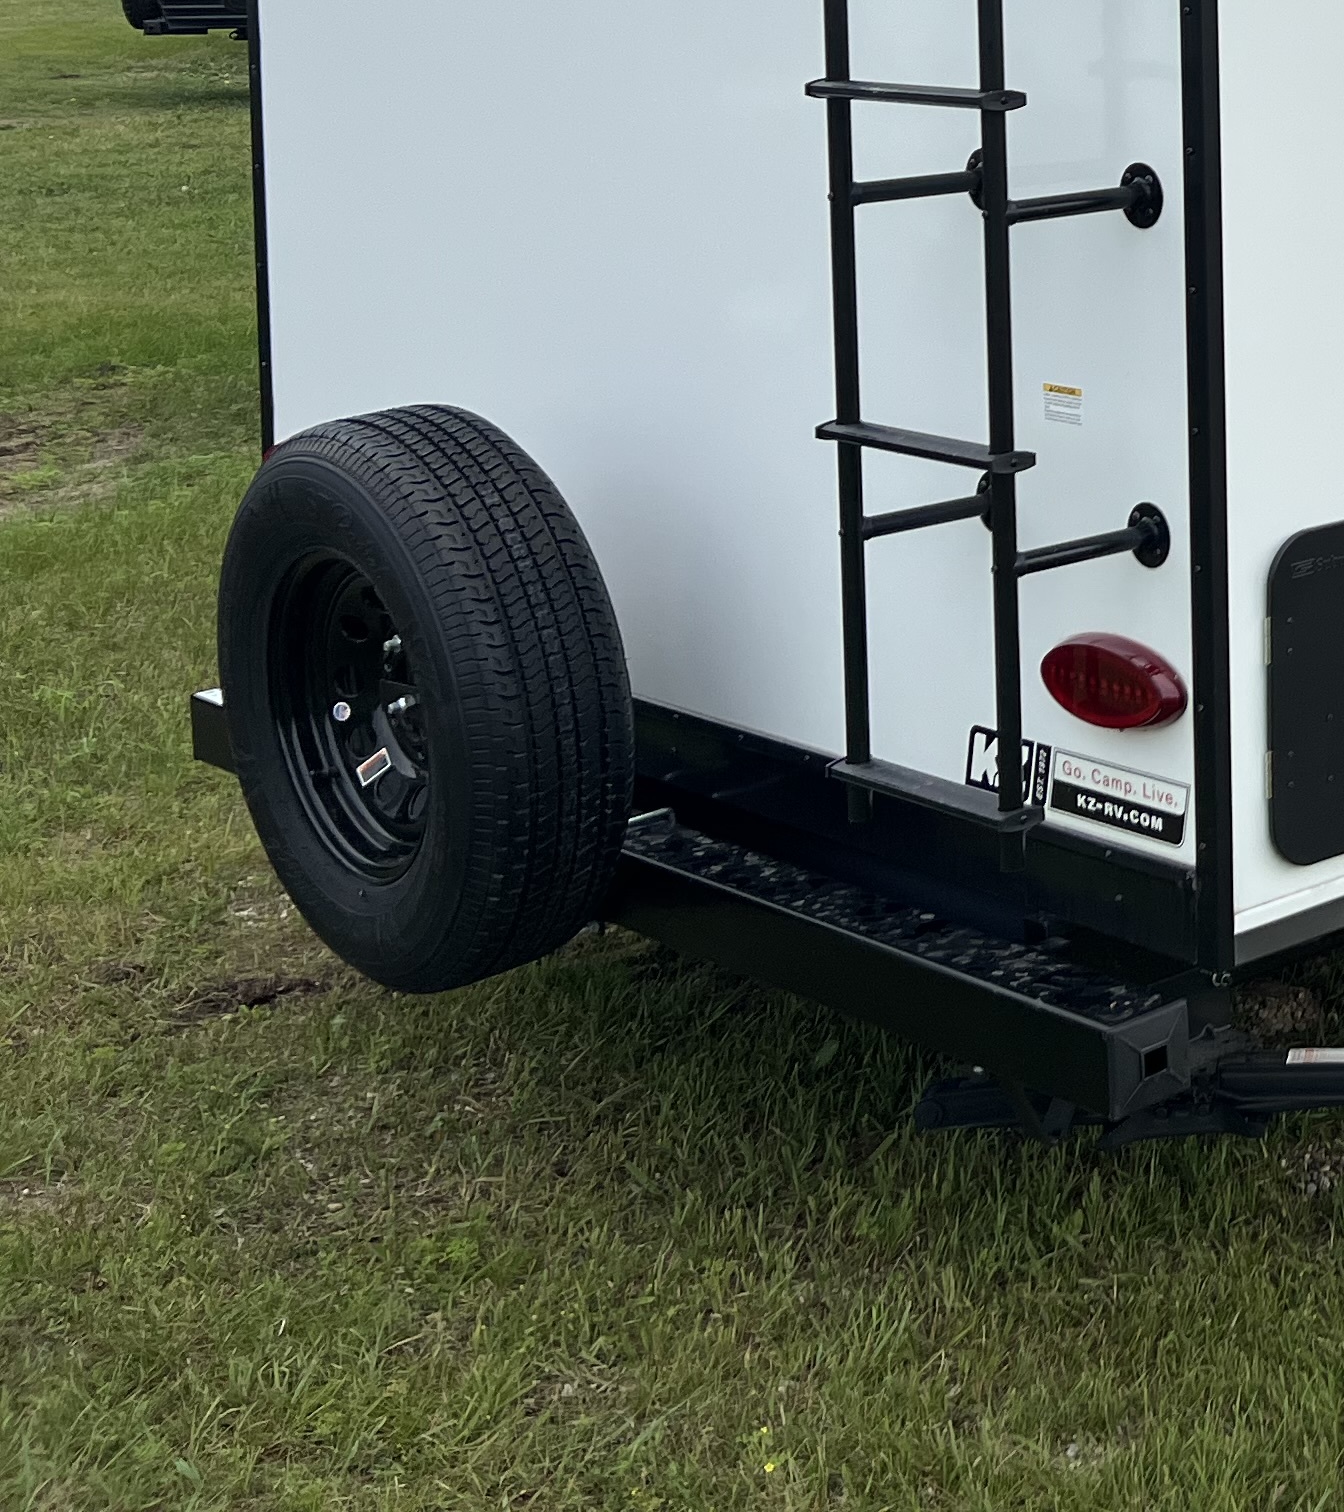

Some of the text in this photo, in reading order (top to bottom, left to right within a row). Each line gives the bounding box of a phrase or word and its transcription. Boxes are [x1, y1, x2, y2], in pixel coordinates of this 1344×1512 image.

[1062, 760, 1178, 807] Go. Camp. Live.
[1076, 793, 1163, 832] KZ-RV.COM
